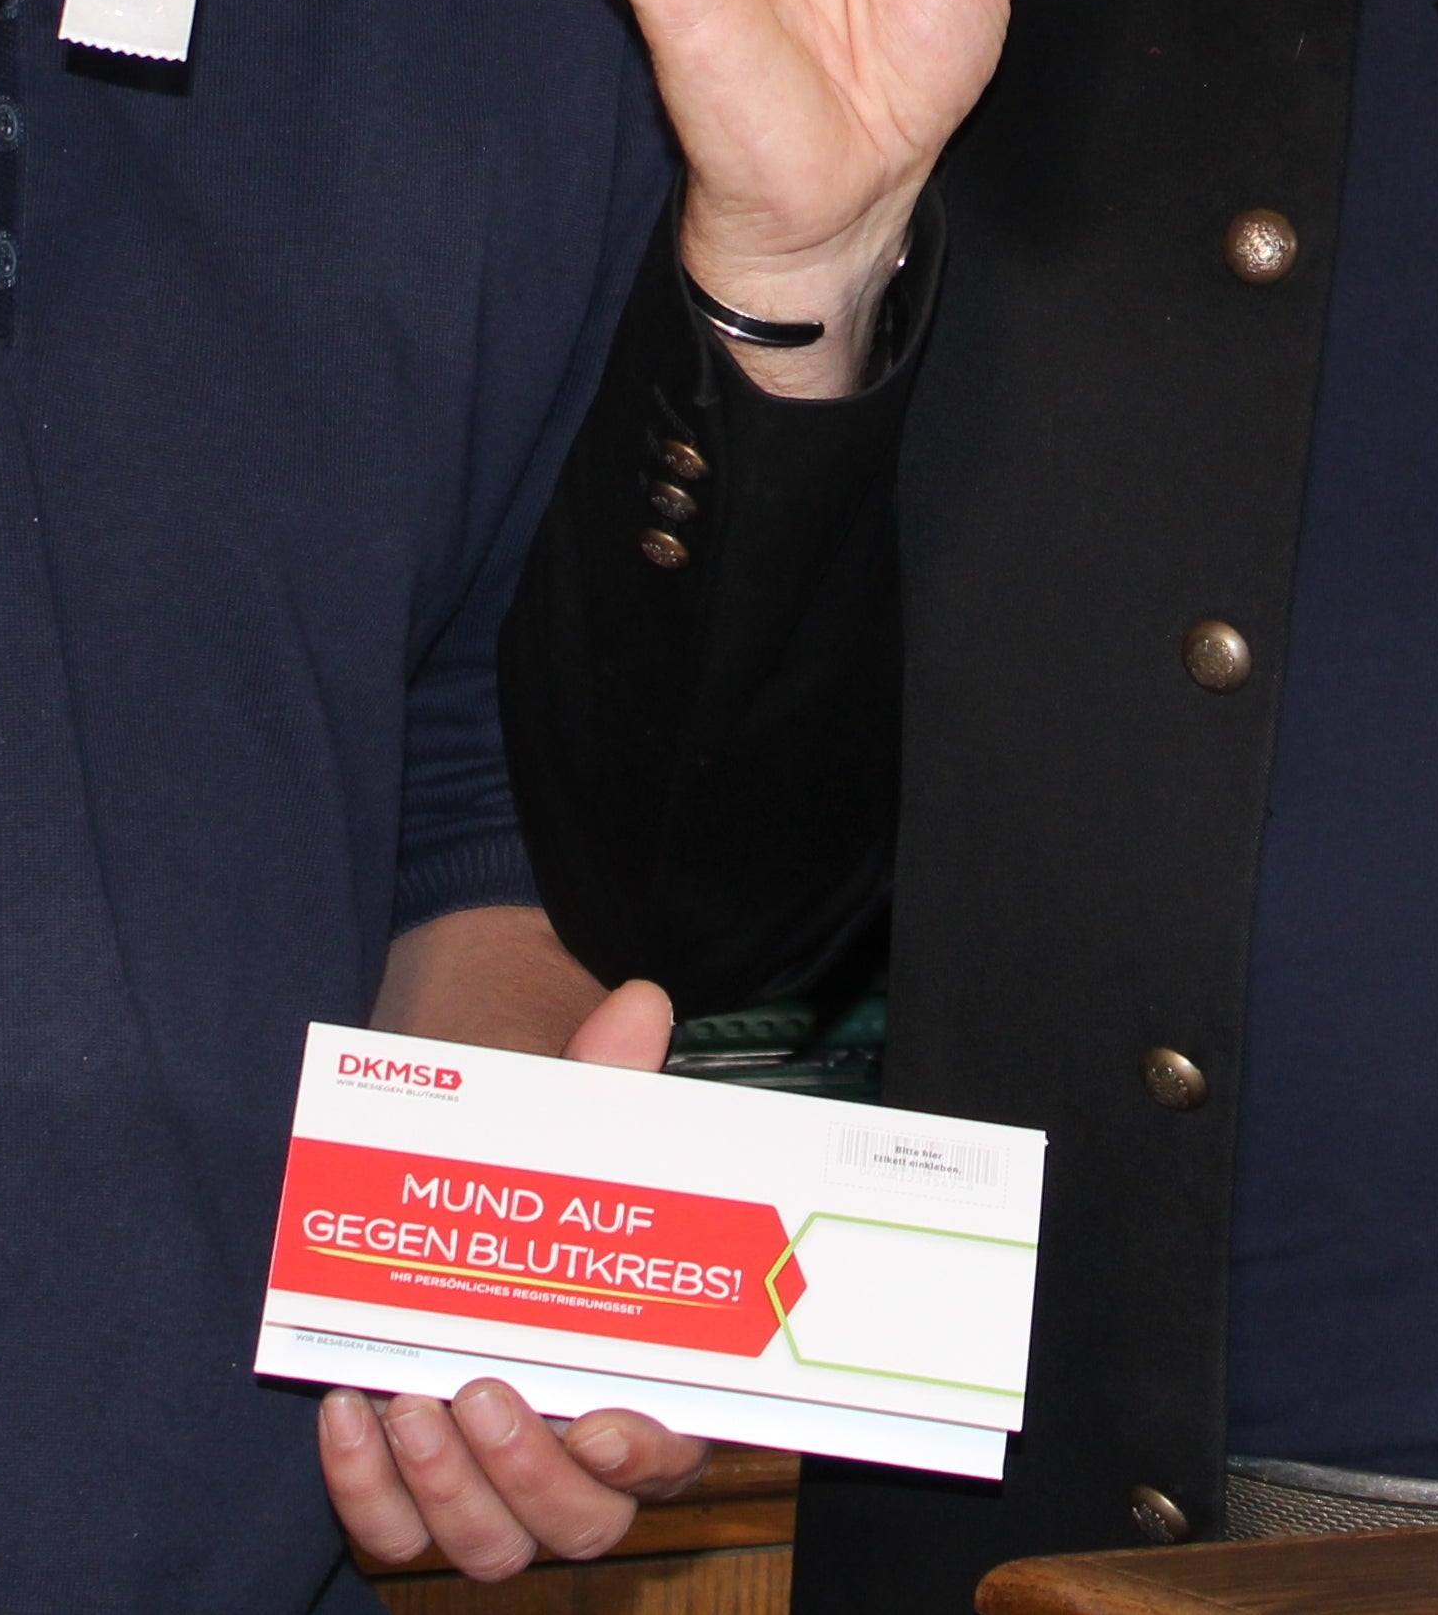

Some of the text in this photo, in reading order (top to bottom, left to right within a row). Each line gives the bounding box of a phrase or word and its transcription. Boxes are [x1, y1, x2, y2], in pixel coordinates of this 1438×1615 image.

[338, 1053, 431, 1086] DKMS
[336, 1078, 459, 1102] WIR BESIEGEN BLUTKREBS
[874, 1154, 906, 1166] Etikett
[895, 1146, 943, 1160] Bitte hier
[403, 1174, 654, 1235] MUND AUF
[304, 1210, 741, 1301] GEGEN BLUTKREBS!
[390, 1271, 643, 1316] IHR PERSÖNLICHES REGISTRIERUNGSSET
[296, 1333, 420, 1358] WIR BESIEGEN BLUTKREBS
